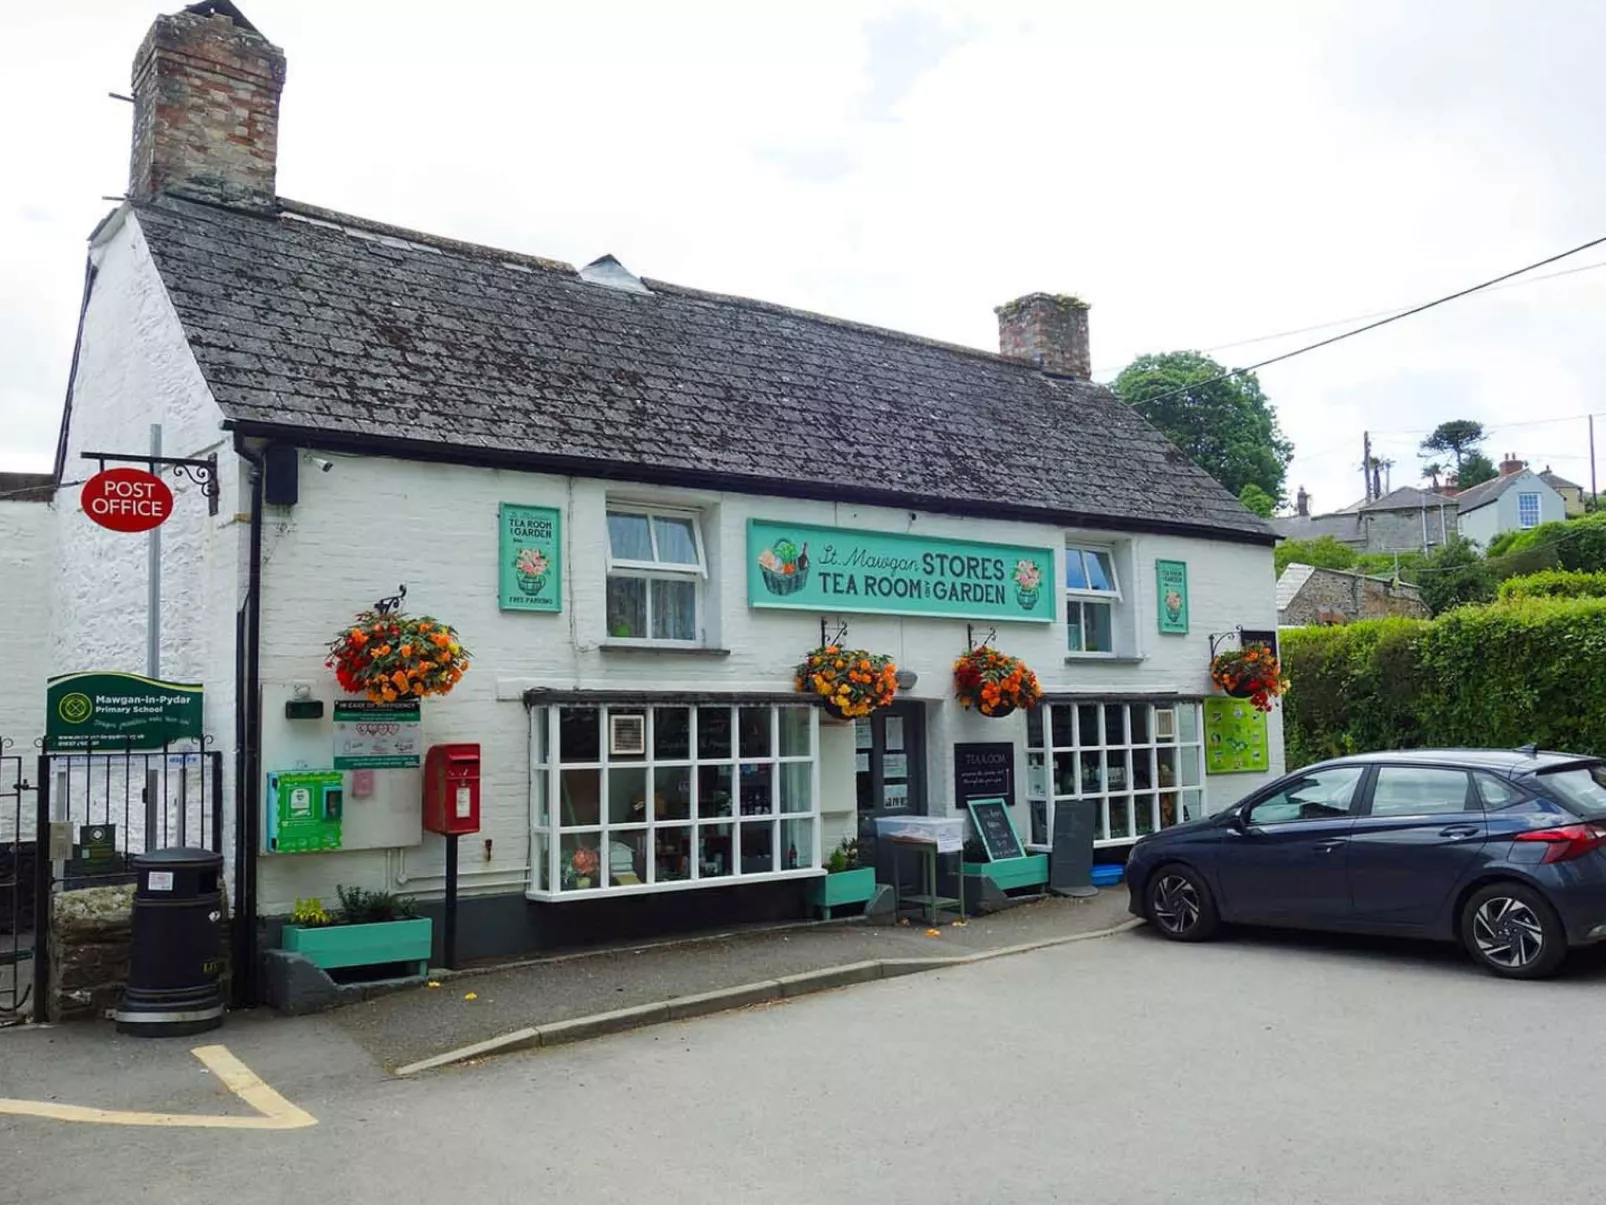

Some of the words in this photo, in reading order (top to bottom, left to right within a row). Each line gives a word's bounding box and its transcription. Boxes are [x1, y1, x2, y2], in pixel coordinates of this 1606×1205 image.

[104, 480, 155, 498] POST
[91, 498, 164, 517] OFFICE
[509, 519, 525, 527] TEA
[527, 520, 552, 529] ROOM
[514, 528, 552, 538] GARDEN
[843, 547, 919, 577] Mawgan
[922, 552, 1005, 581] STORES
[818, 572, 858, 595] TEA
[864, 575, 921, 599] ROOM
[933, 580, 1006, 605] GARDEN
[95, 695, 191, 706] Mawgan-in-Pydar
[95, 706, 131, 714] Primary
[133, 705, 163, 713] School
